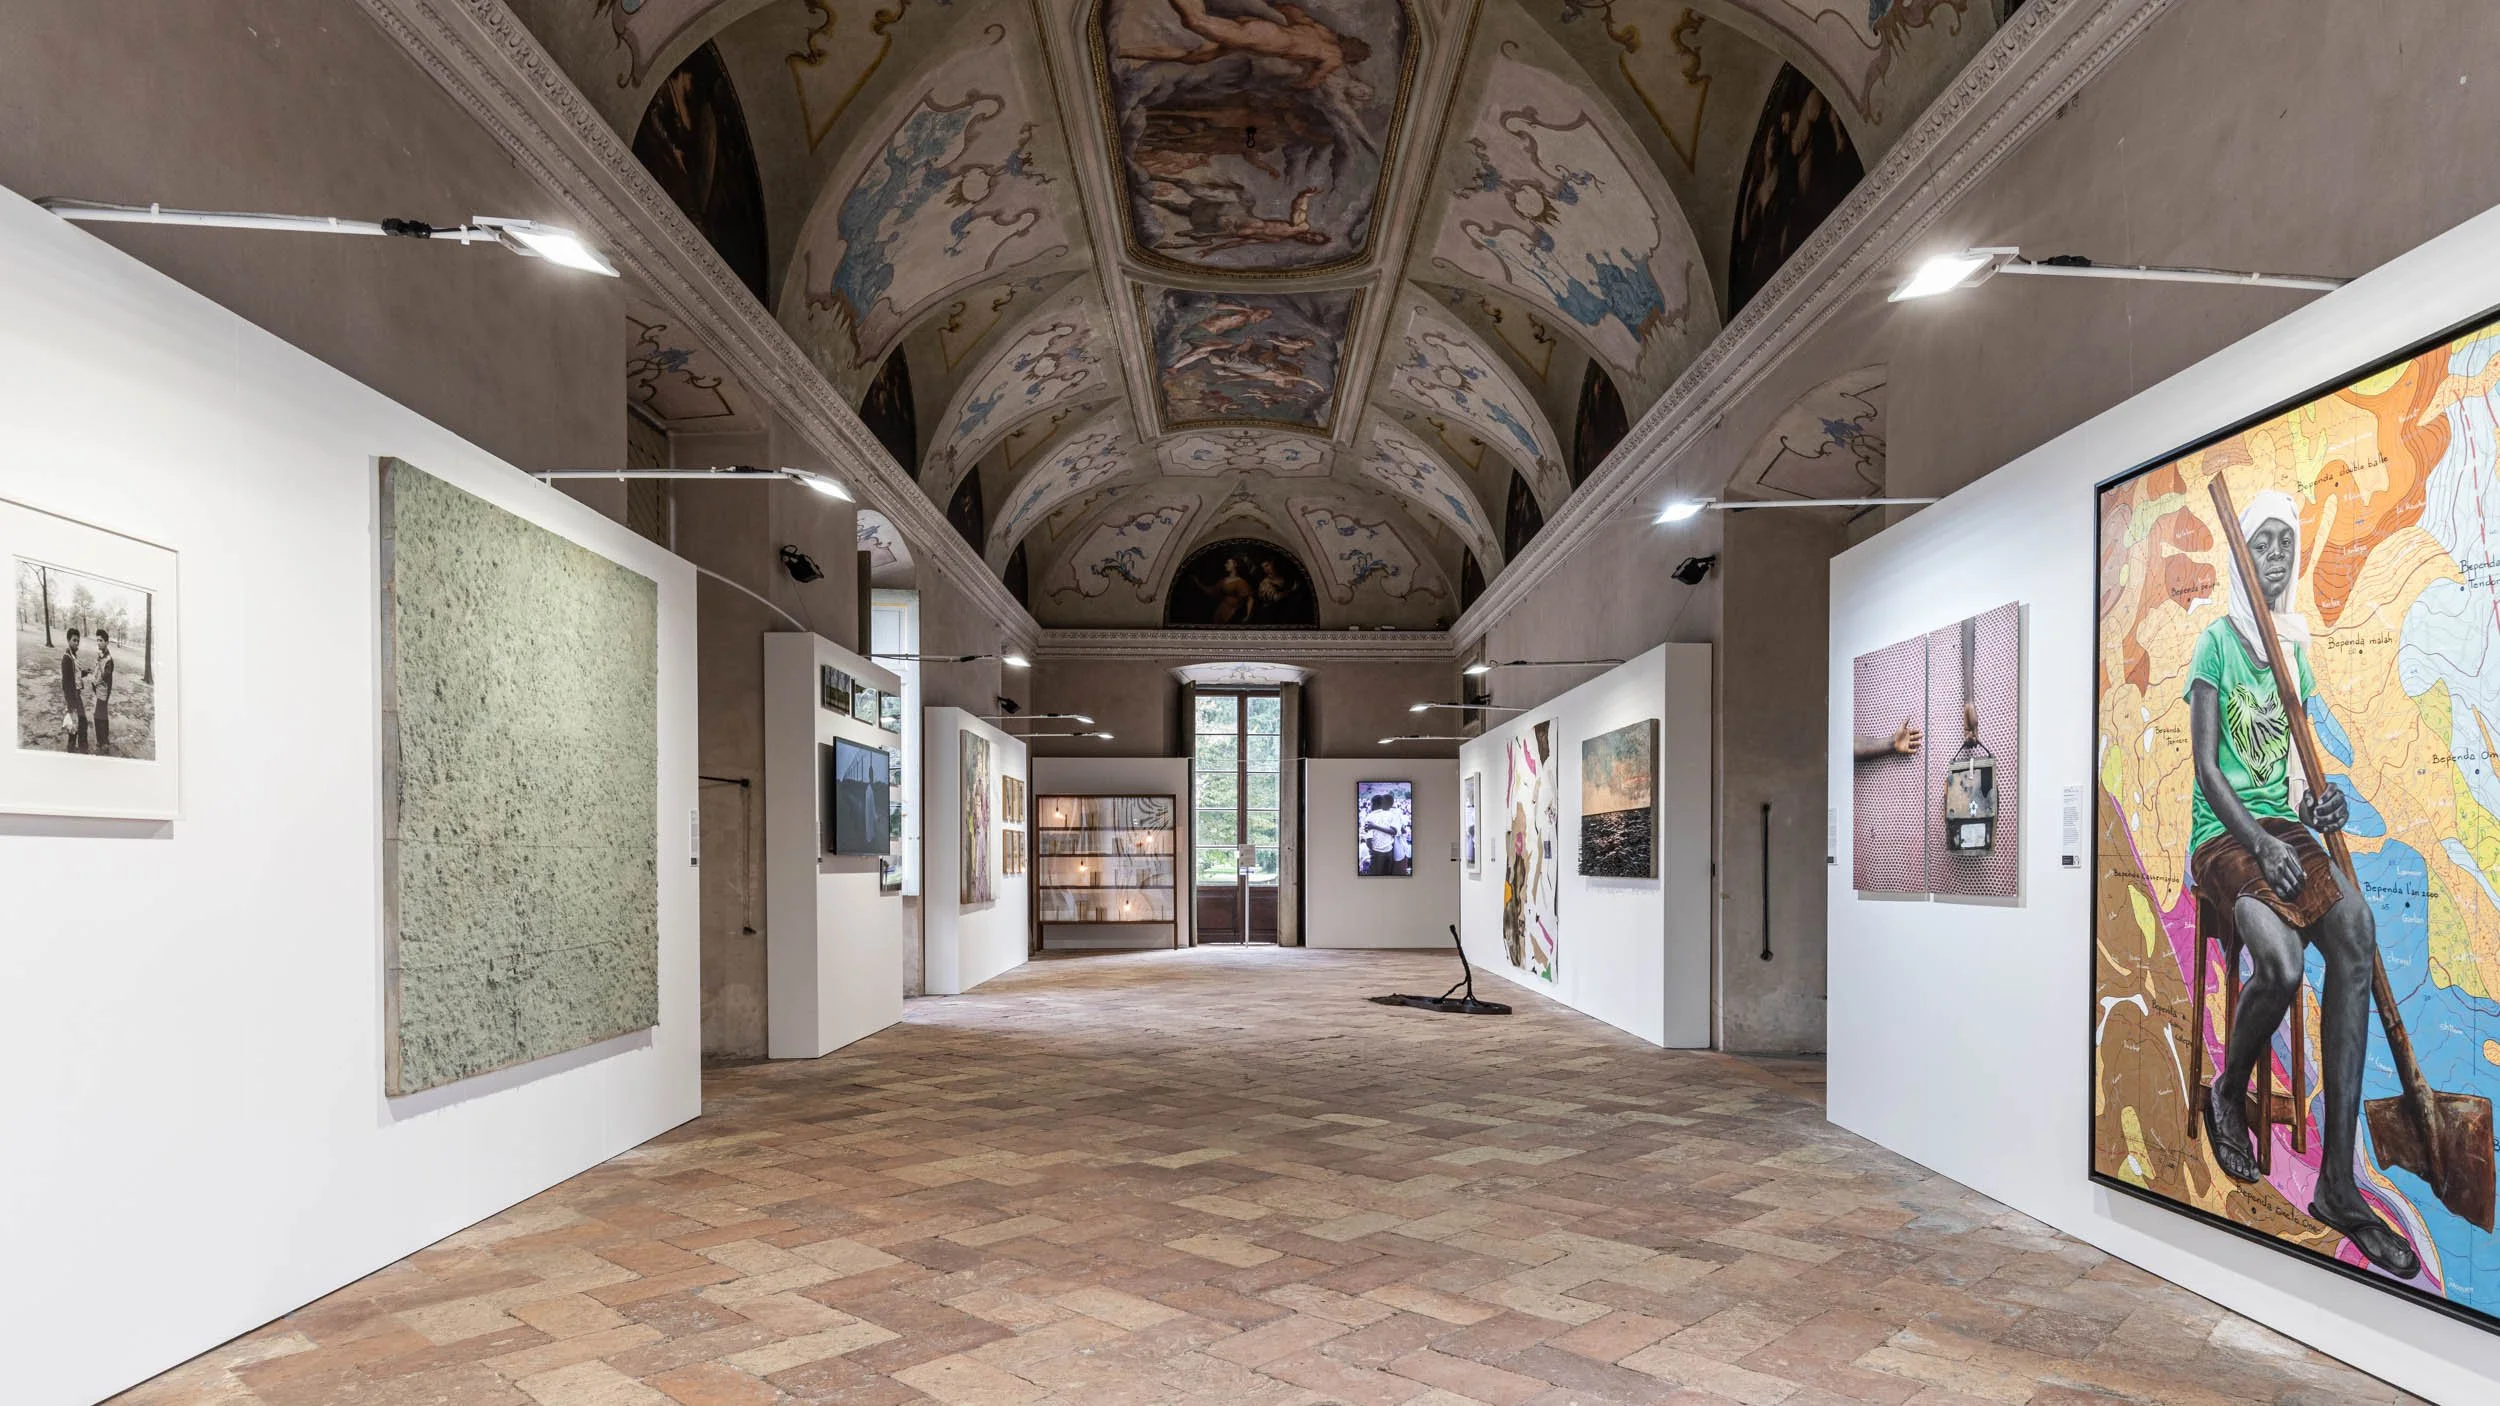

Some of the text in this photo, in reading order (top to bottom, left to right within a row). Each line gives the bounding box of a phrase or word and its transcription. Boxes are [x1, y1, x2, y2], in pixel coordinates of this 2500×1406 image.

[2339, 459, 2364, 477] double
[2327, 632, 2365, 654] Bependa
[2432, 748, 2476, 768] Bependa
[2363, 881, 2404, 898] Bependa
